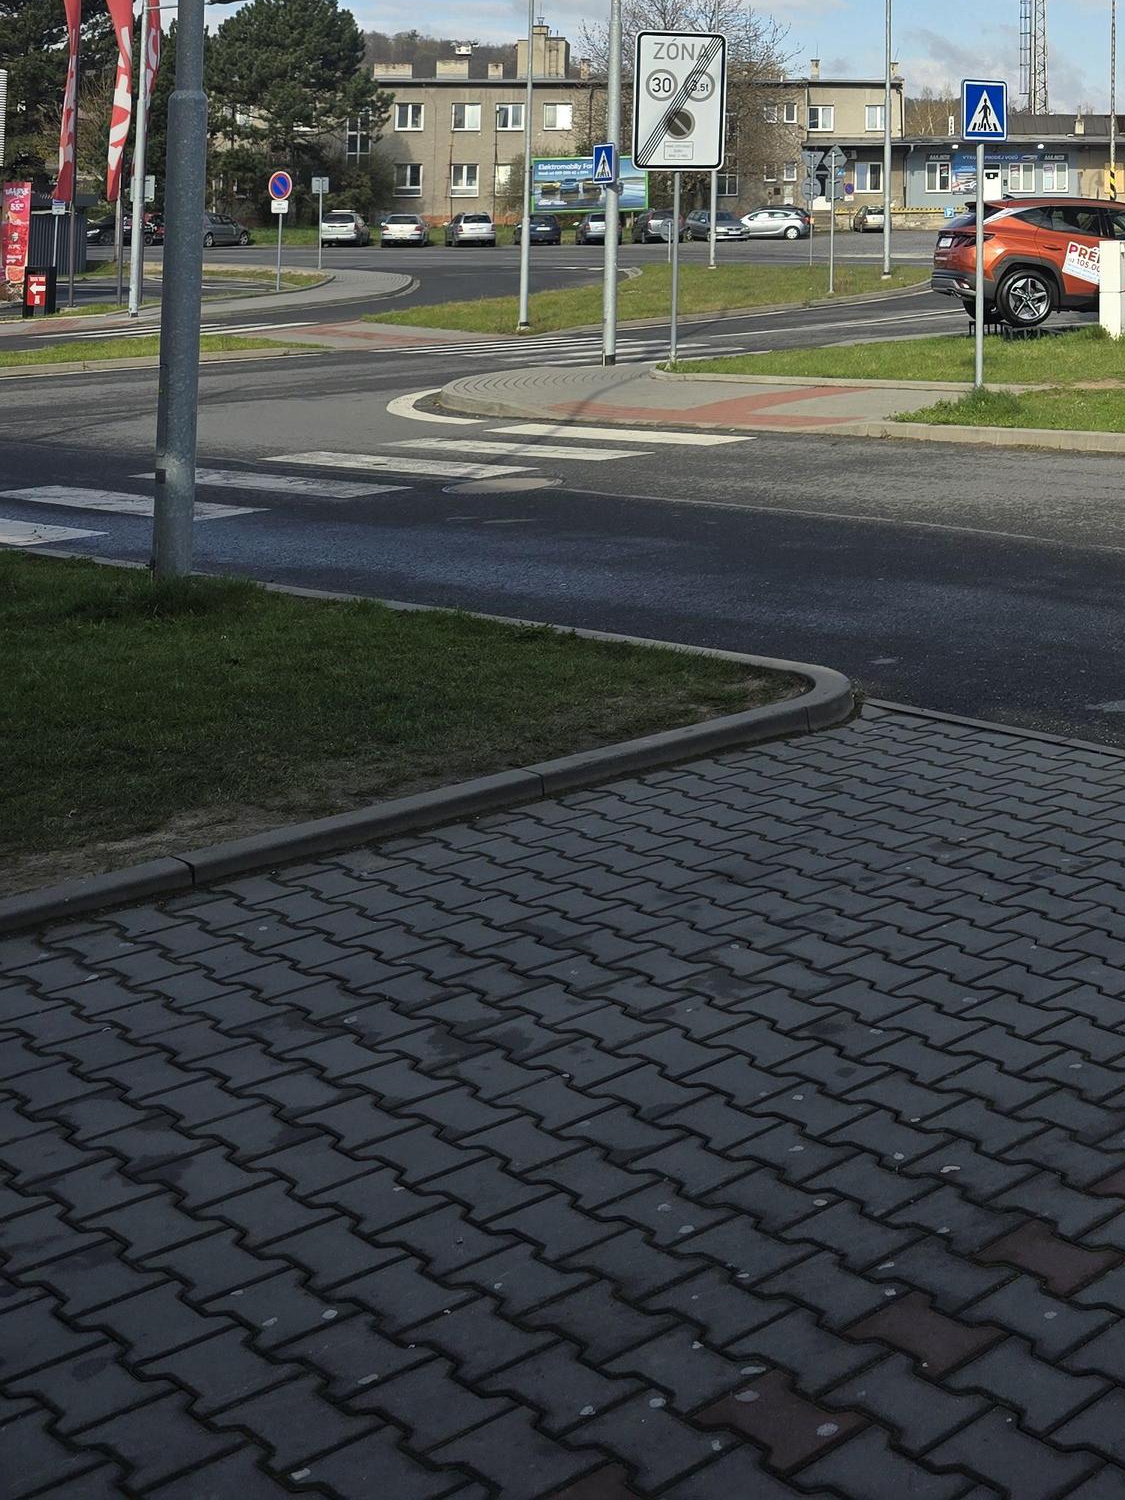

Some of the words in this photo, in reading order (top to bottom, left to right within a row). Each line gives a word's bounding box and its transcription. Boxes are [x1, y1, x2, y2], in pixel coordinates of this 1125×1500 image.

[653, 38, 711, 60] ZÓNA
[652, 77, 672, 93] 30
[538, 162, 581, 171] Elektromobily
[583, 162, 594, 170] For
[1068, 243, 1100, 263] PRÉ
